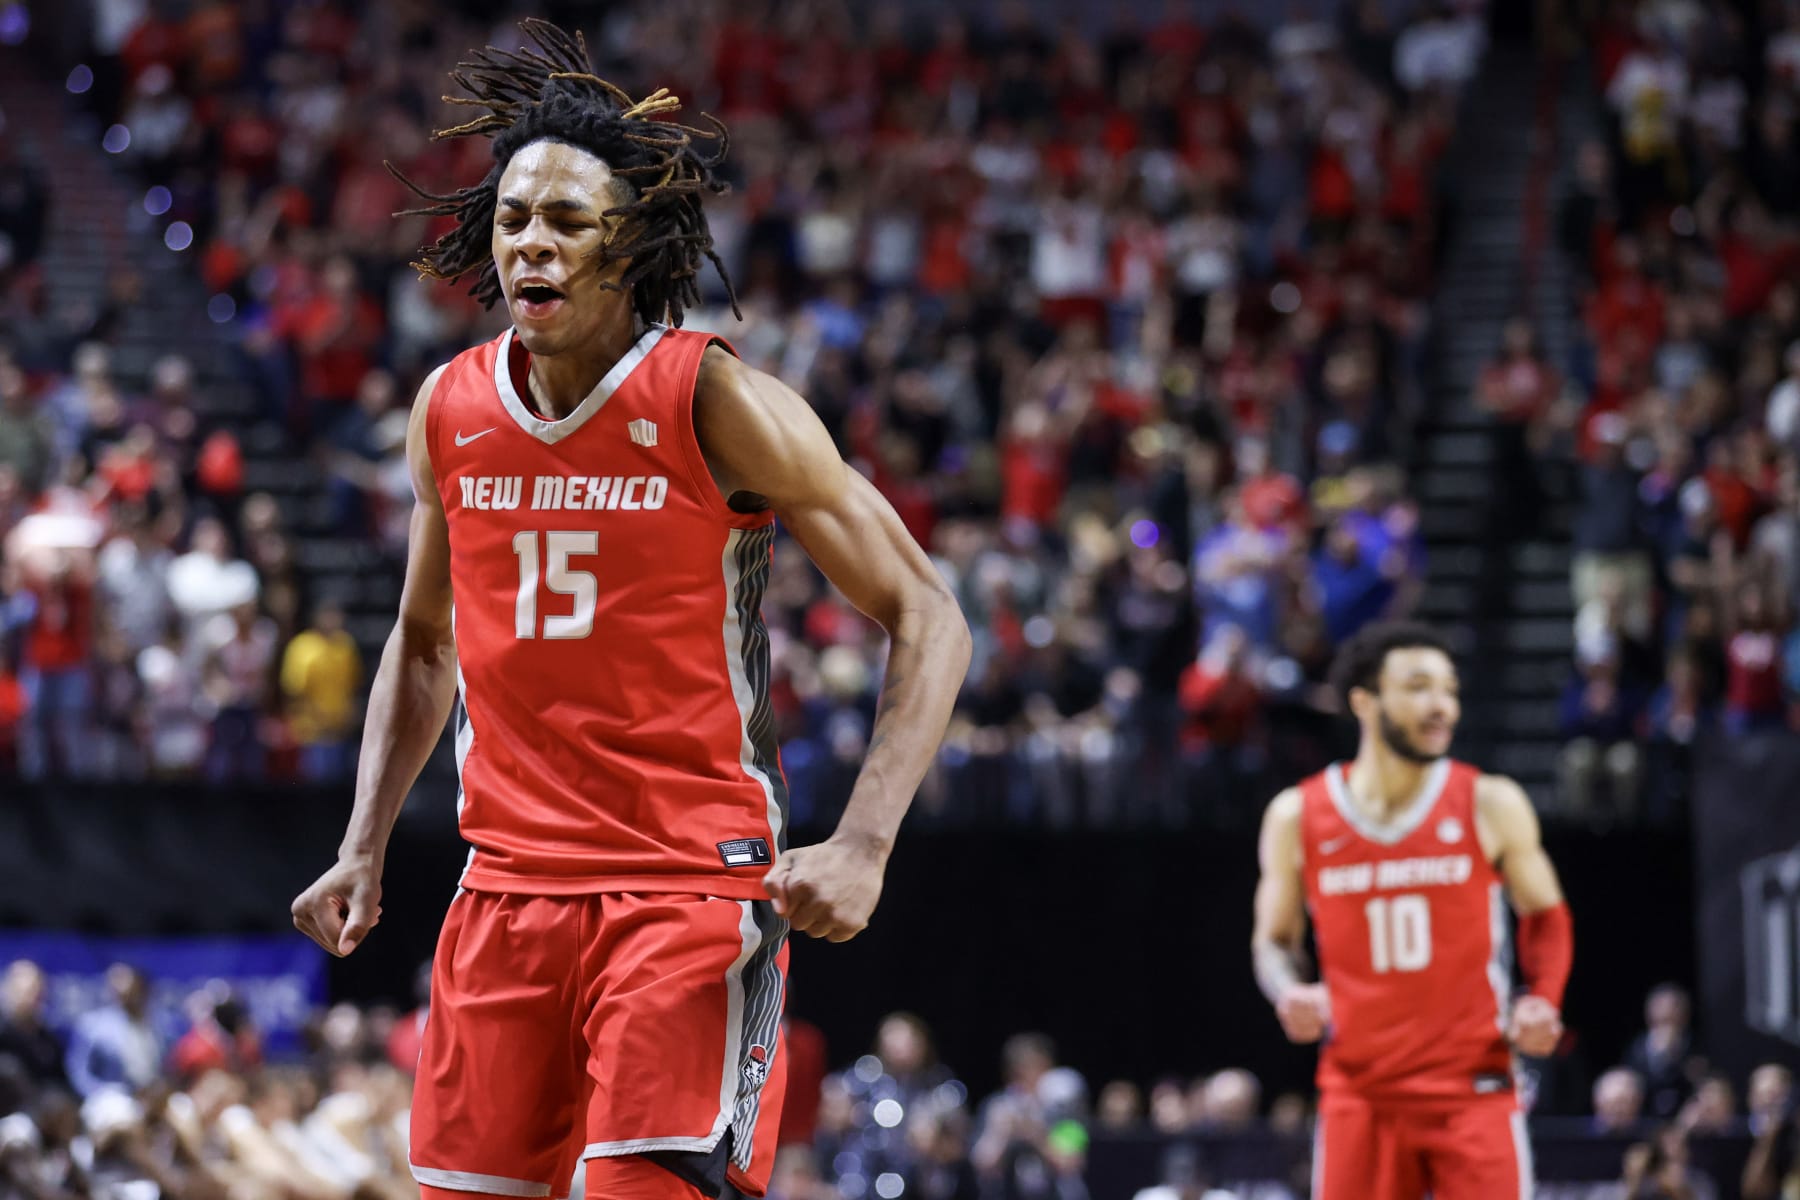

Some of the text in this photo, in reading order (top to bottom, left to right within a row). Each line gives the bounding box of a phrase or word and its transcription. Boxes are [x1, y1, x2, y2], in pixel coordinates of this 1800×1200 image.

[459, 476, 669, 511] NEW MEXICO
[512, 530, 599, 640] 15
[756, 845, 765, 857] L
[1365, 894, 1432, 974] 10
